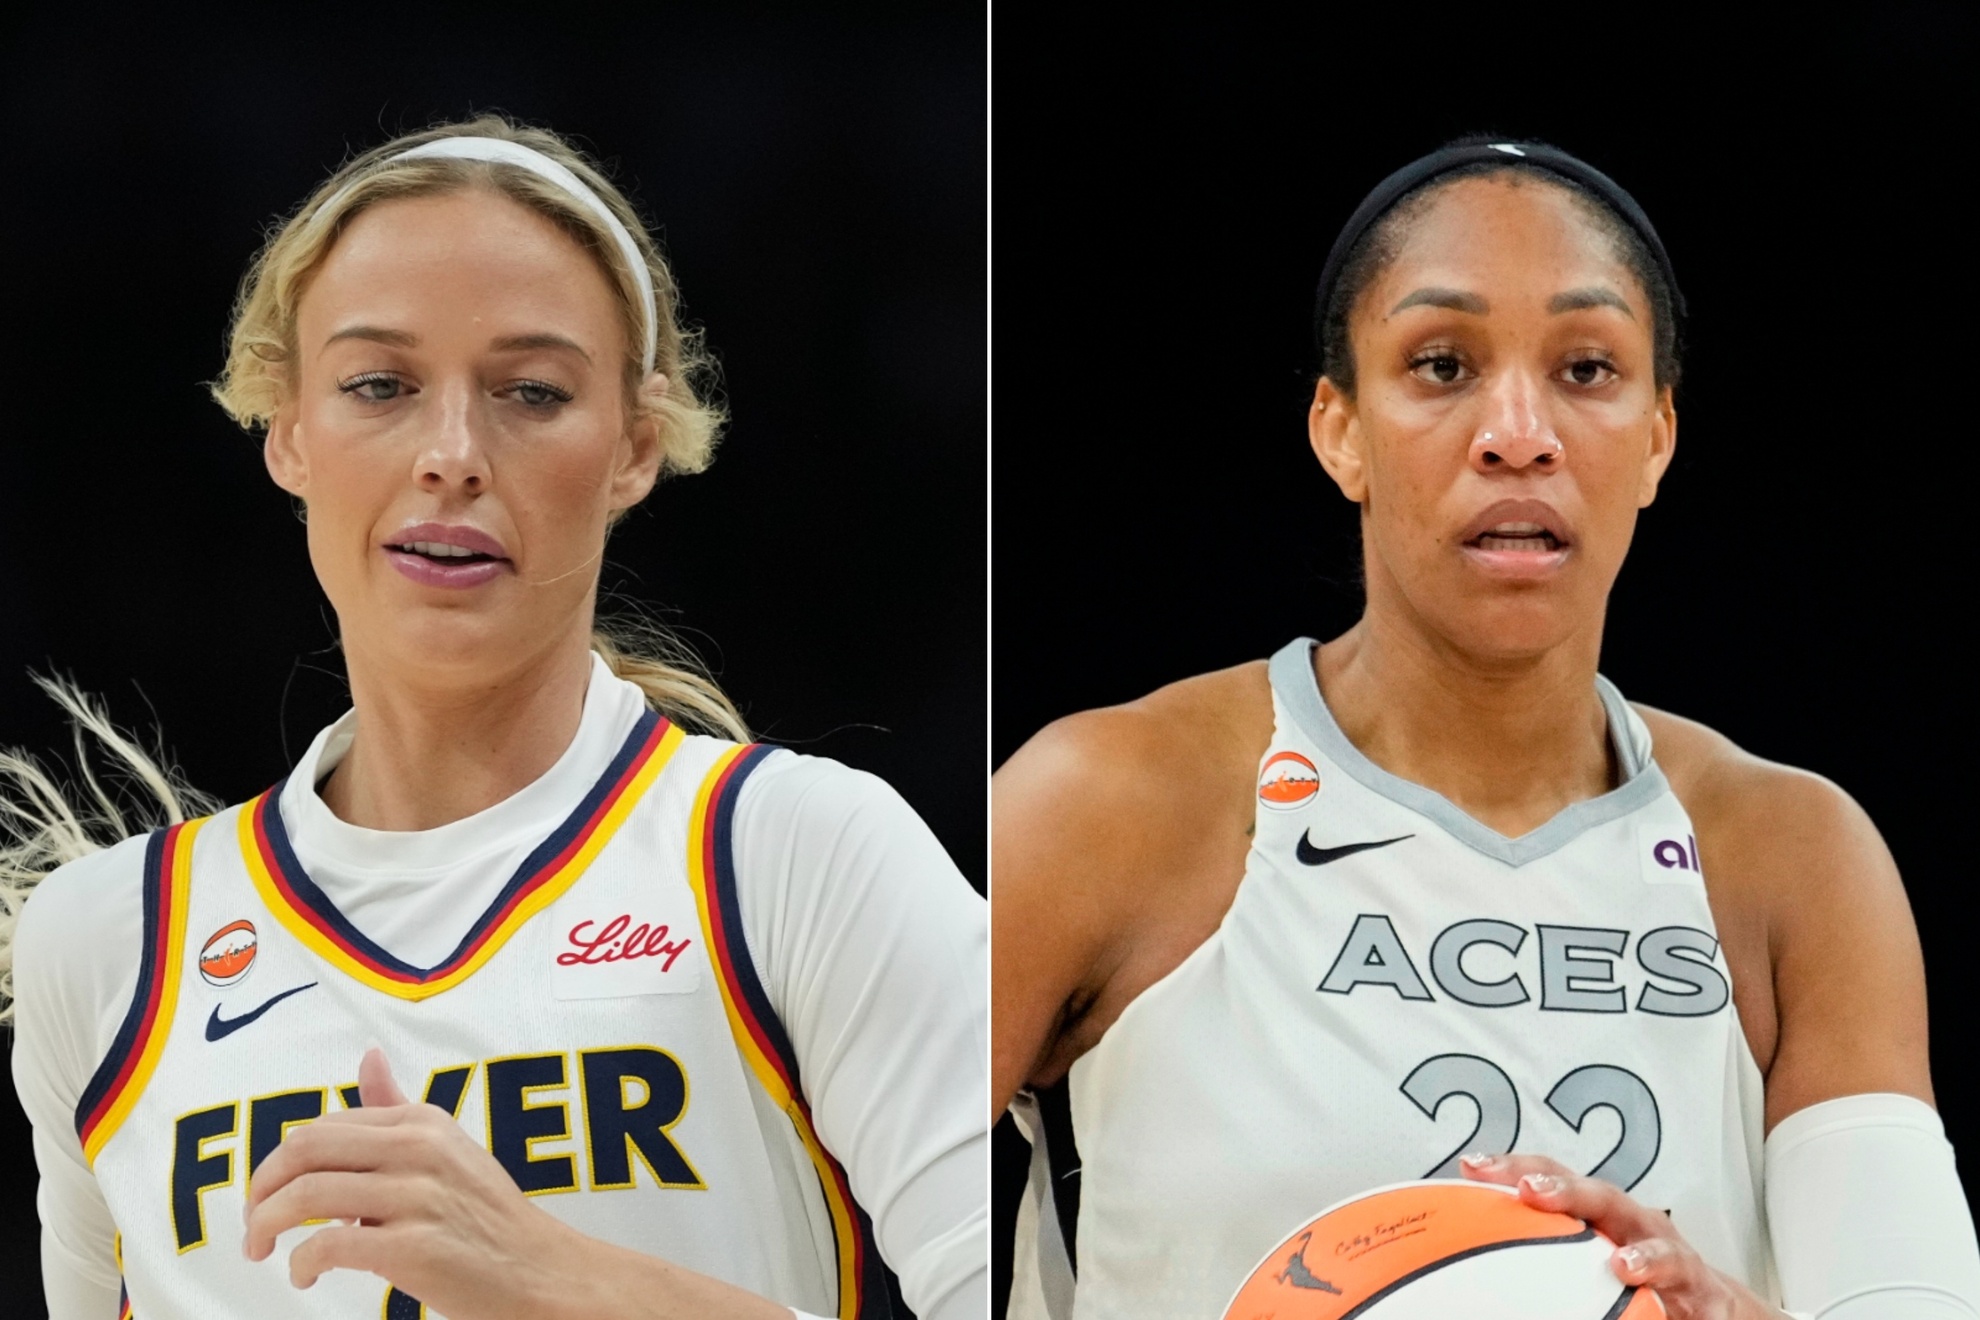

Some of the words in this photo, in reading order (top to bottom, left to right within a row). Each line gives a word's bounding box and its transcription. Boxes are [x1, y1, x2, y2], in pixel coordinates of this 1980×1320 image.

[556, 914, 692, 973] Lilly
[1316, 913, 1730, 1018] ACES
[1400, 1052, 1671, 1217] 22
